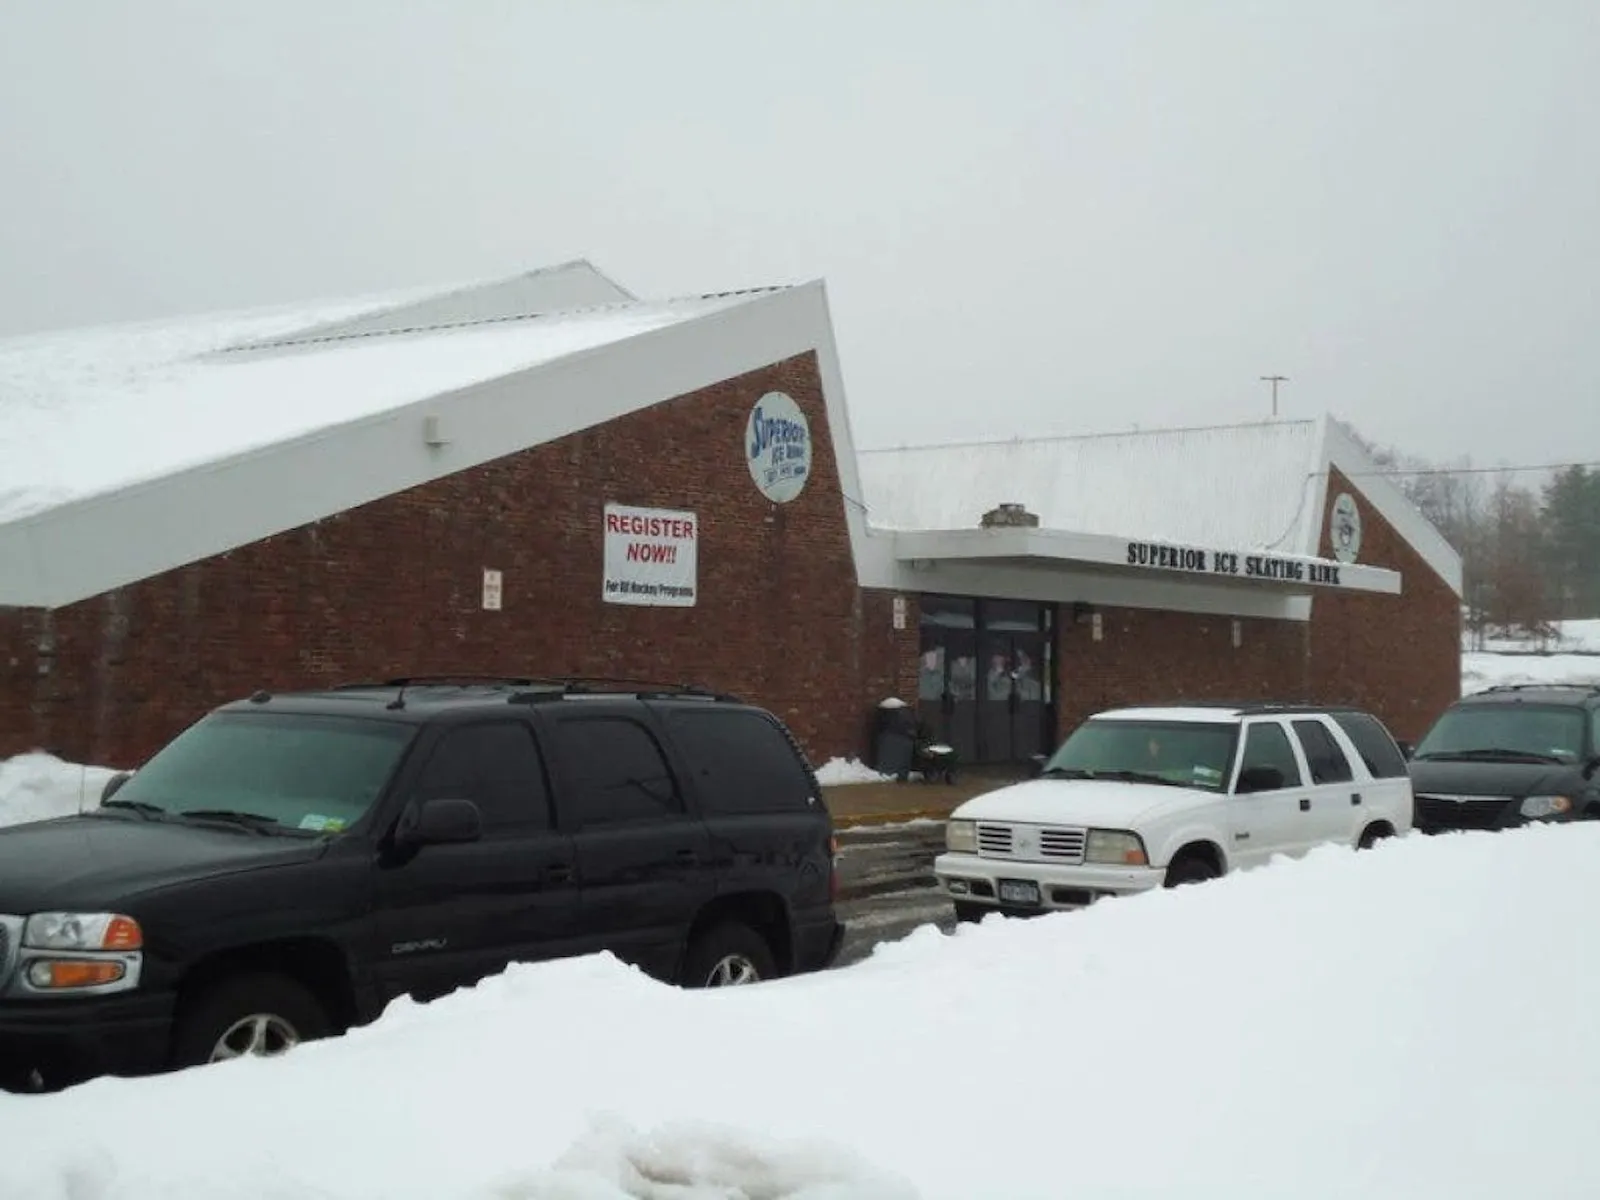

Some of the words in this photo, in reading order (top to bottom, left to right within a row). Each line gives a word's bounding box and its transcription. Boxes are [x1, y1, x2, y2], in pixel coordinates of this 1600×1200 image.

[607, 514, 694, 539] REGISTER
[627, 543, 677, 564] NOW!!
[1128, 543, 1206, 571] SUPERIOR
[1214, 552, 1239, 573] ICE
[1246, 556, 1303, 579] SKATING
[1309, 564, 1340, 584] RINK
[606, 580, 619, 592] For
[631, 582, 658, 596] Hockey
[659, 584, 694, 598] Programs
